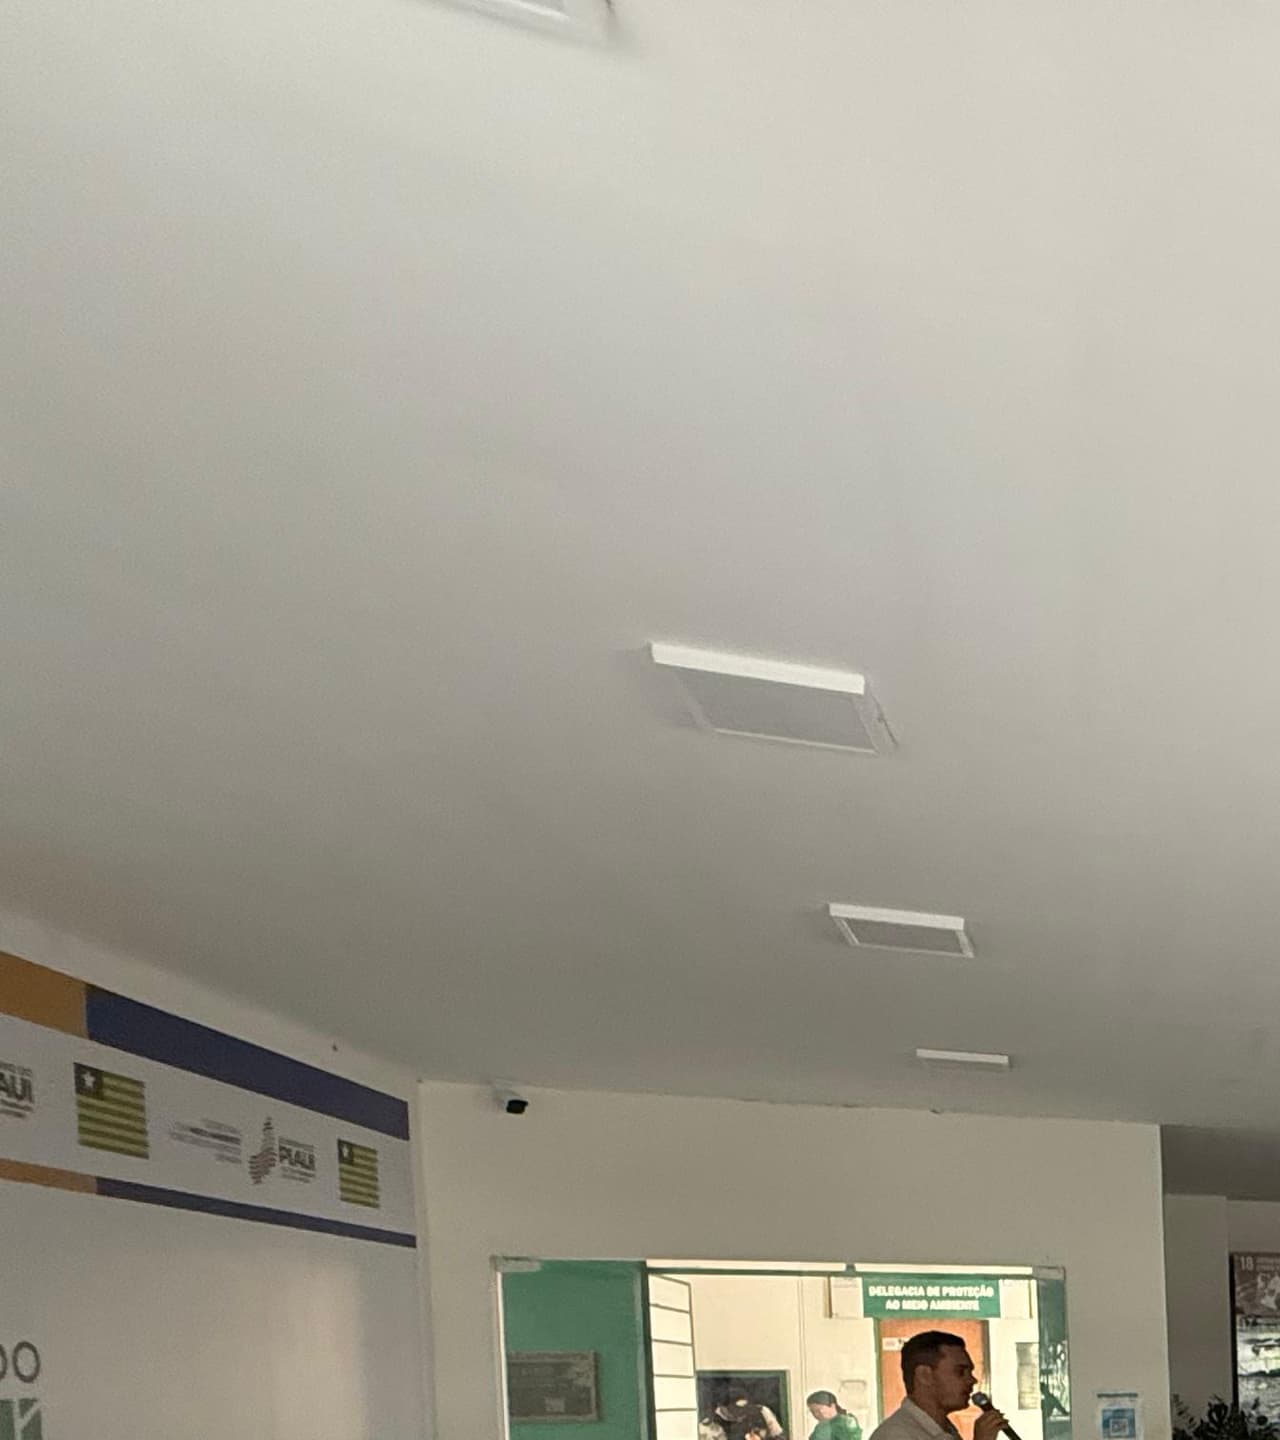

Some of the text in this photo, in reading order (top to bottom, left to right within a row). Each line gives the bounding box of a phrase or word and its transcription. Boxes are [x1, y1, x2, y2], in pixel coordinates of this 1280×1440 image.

[868, 1284, 995, 1299] DELEGACIA DE PROTEÇÃO
[885, 1299, 980, 1311] AO MEIO AMBIENTE
[0, 1341, 40, 1383] O
